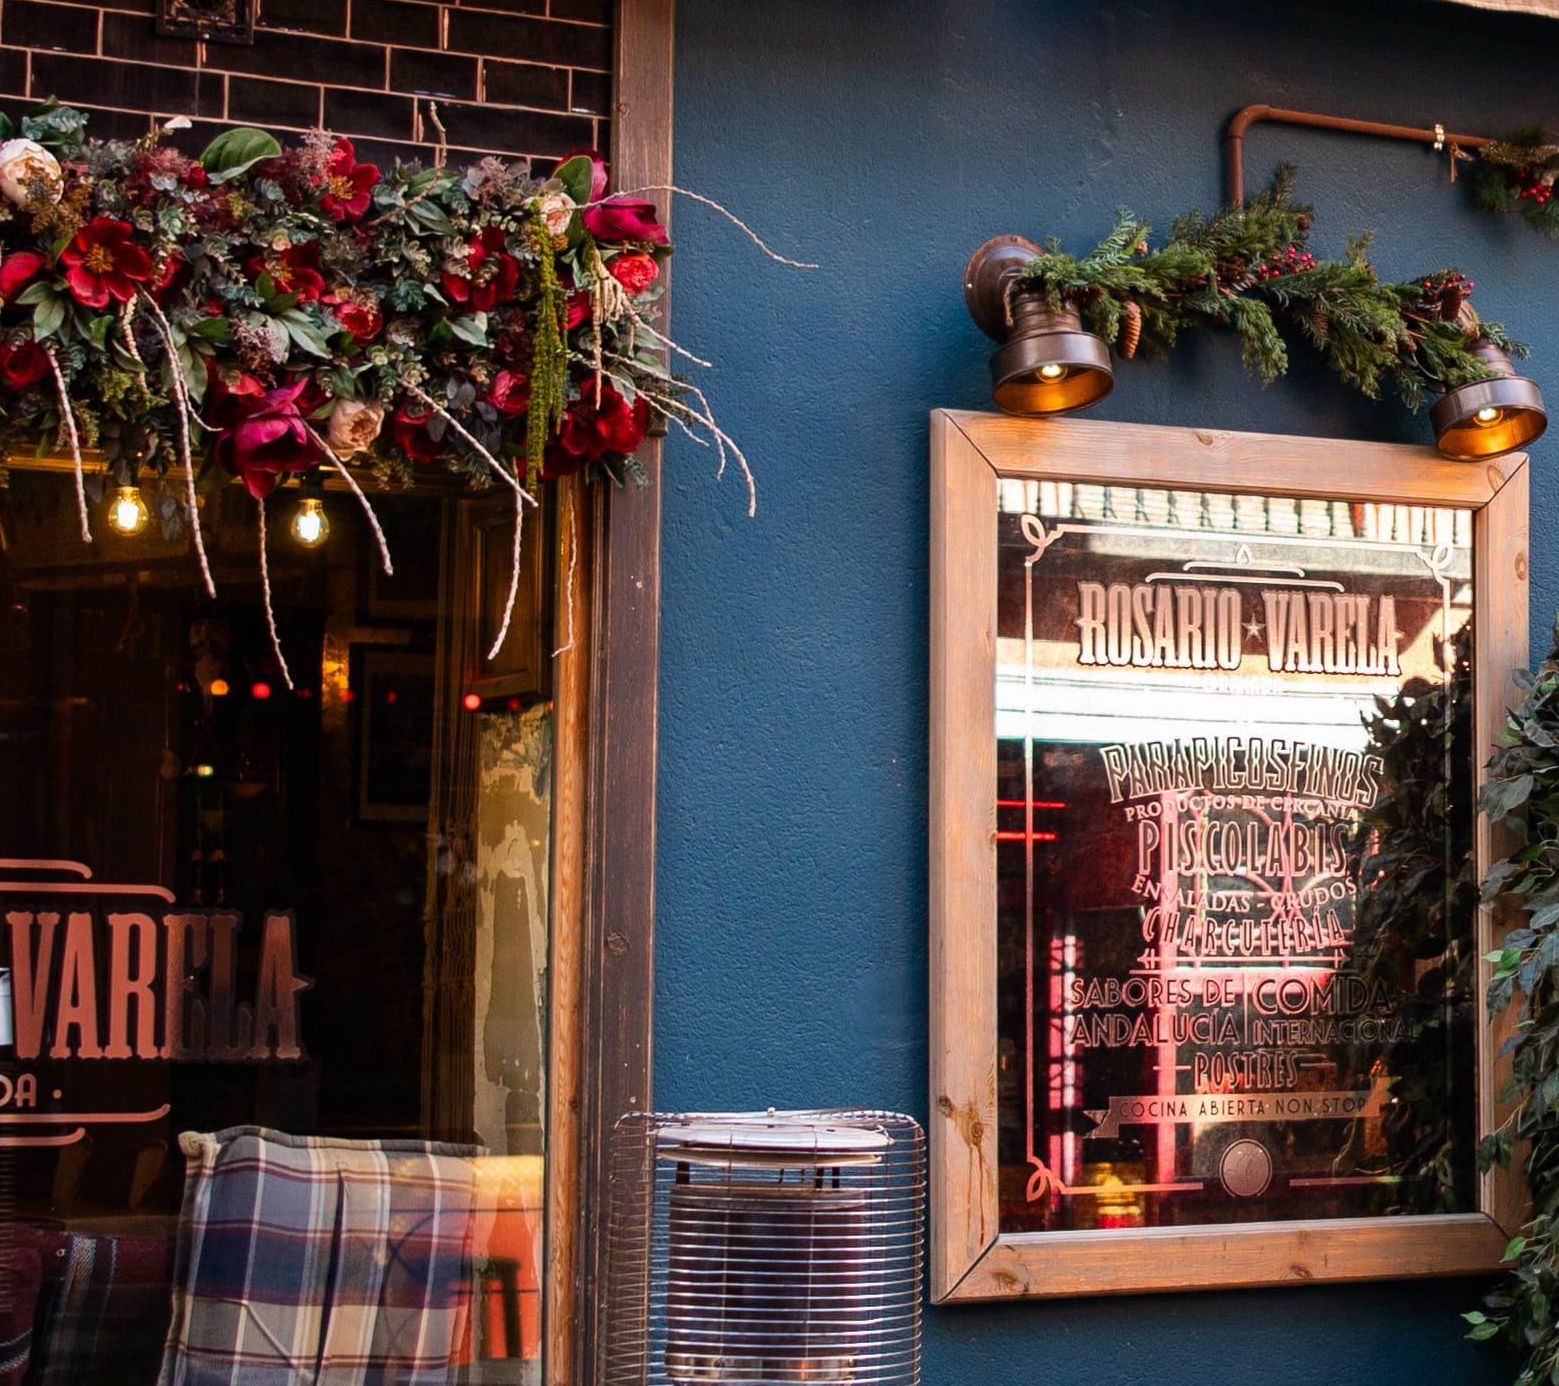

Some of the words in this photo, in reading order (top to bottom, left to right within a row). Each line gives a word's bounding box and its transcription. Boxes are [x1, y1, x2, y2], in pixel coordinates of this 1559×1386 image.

[1074, 581, 1241, 670] ROSARIO
[1261, 590, 1405, 676] VARELA
[1124, 794, 1235, 822] PRODUCTOS
[1242, 795, 1265, 809] DE
[1139, 820, 1349, 877] PISCOLABIS
[1131, 874, 1250, 913] ENSALADAS
[1271, 876, 1357, 911] CRUDOS
[6, 908, 312, 1061] VARELA
[1070, 978, 1192, 1009] SABORES
[1202, 978, 1235, 1007] DE
[1252, 976, 1391, 1015] COMIDA
[1253, 1019, 1418, 1045] INTERNACIONAL
[1194, 1051, 1298, 1088] POSTRES
[1120, 1100, 1187, 1118] COCINA
[1199, 1098, 1265, 1116] ABIERTA
[1276, 1098, 1313, 1114] NON
[1321, 1096, 1366, 1113] STOP
